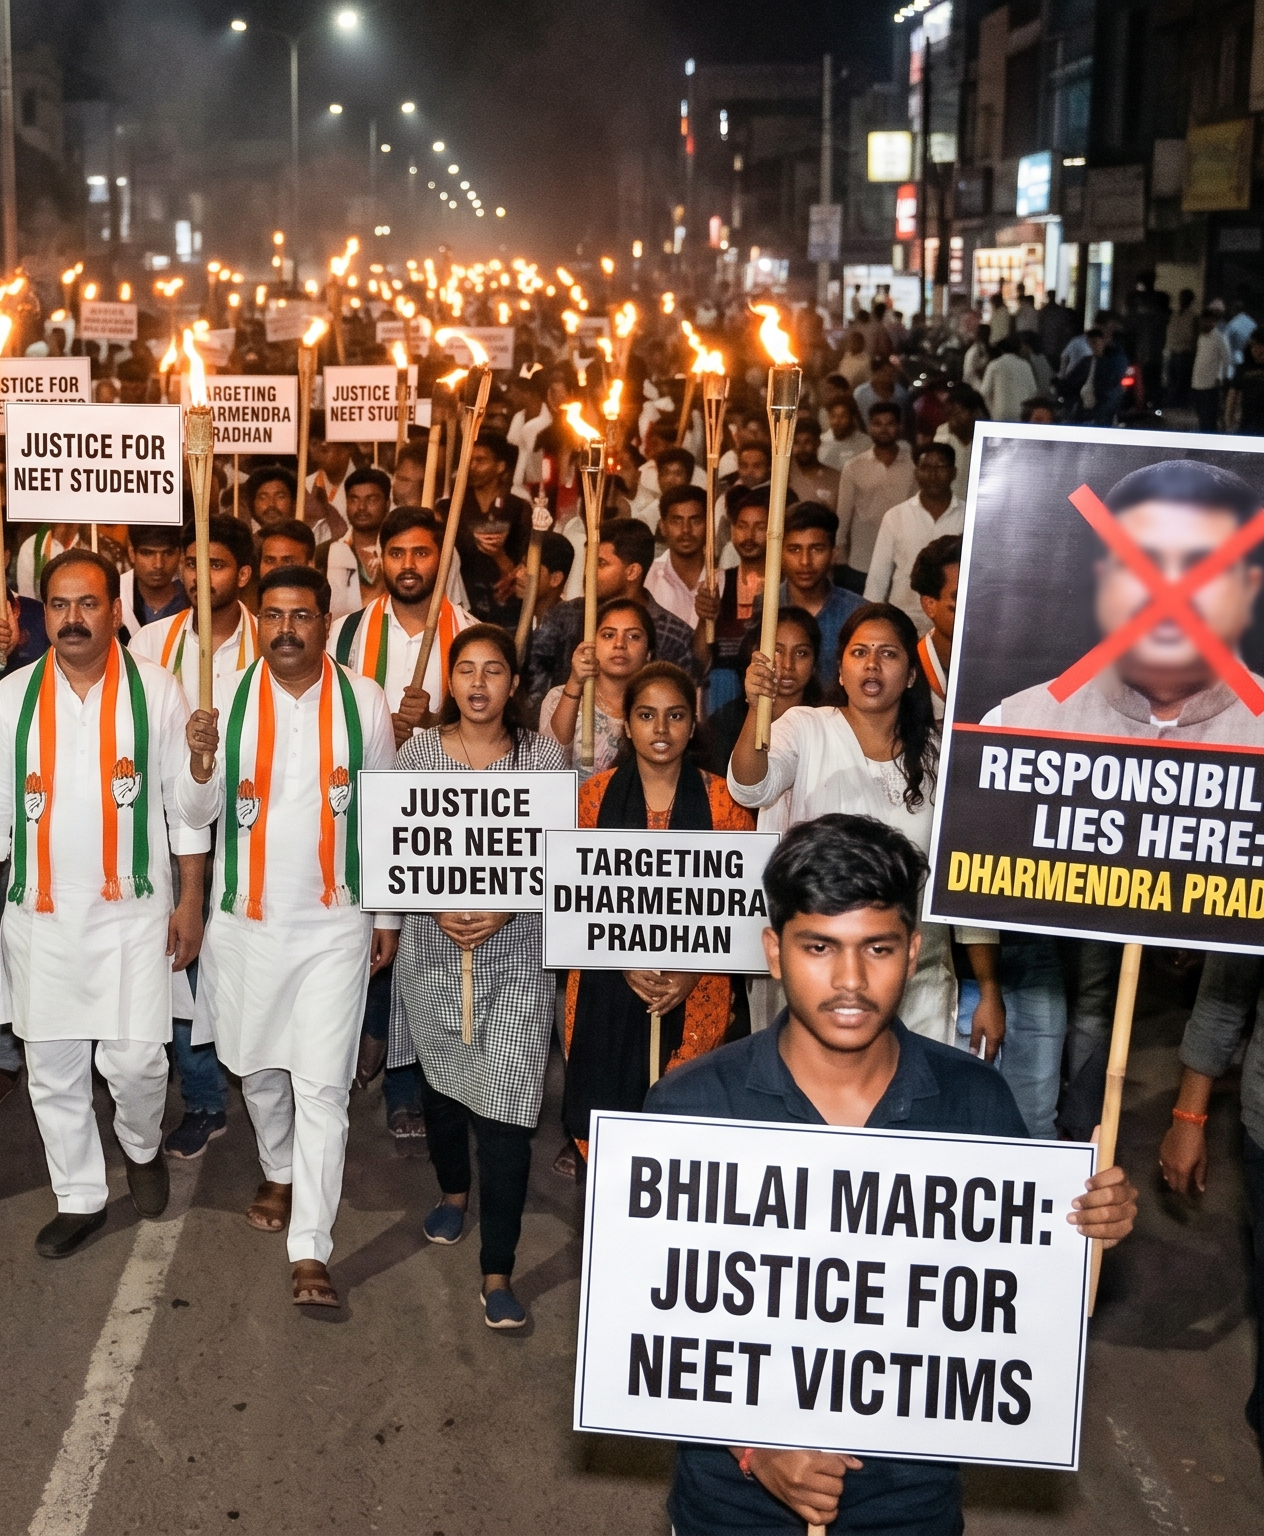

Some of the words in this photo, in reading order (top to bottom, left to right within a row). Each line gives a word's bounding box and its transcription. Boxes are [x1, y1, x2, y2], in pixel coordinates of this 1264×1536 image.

[49, 376, 79, 393] FOR
[206, 386, 277, 402] RGETING
[332, 385, 390, 401] JUSTICE
[331, 406, 364, 421] NEET
[21, 432, 113, 459] JUSTICE
[122, 434, 165, 460] FOR
[213, 427, 272, 443] RADHAN
[14, 467, 64, 491] NEET
[70, 468, 174, 494] STUDENTS
[979, 745, 1263, 812] RESPONSIBIL
[400, 788, 530, 817] JUSTICE
[392, 827, 453, 856] FOR
[465, 827, 542, 856] NEET
[1033, 804, 1125, 855] LIES
[576, 847, 743, 879] TARGETING
[388, 866, 543, 896] STUDENTS
[947, 851, 1172, 912] DHARMENDRA
[554, 884, 767, 917] DHARMENDRA
[587, 923, 731, 954] PRADHAN
[628, 1155, 809, 1231] BHILAI
[830, 1169, 1054, 1247] MARCH:
[650, 1247, 886, 1326] JUSTICE
[906, 1263, 1018, 1335] FOR
[627, 1332, 772, 1407] NEET
[791, 1345, 1033, 1426] VICTIMS
